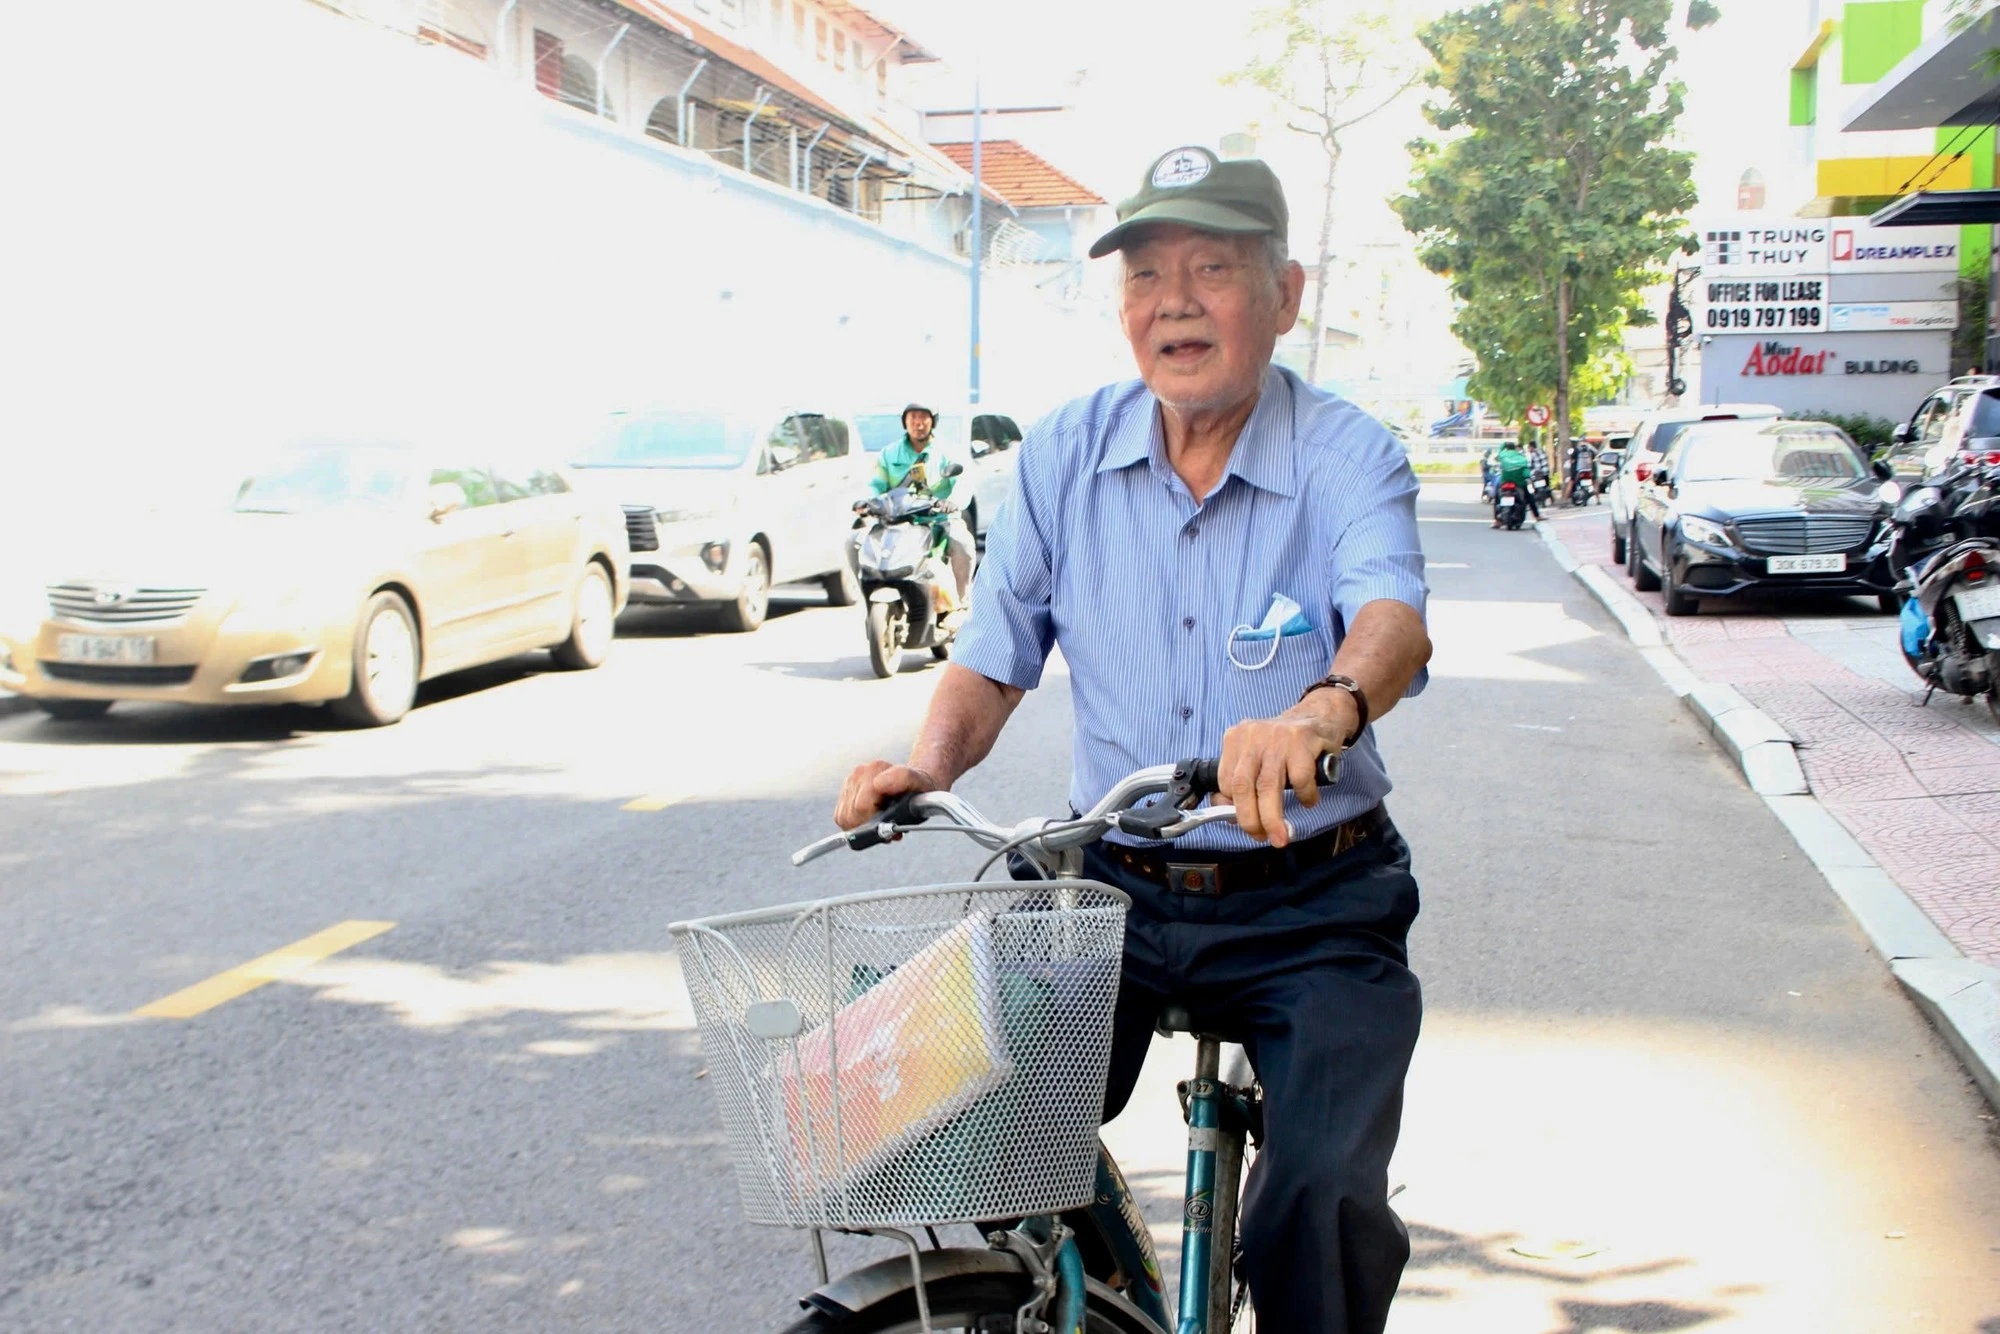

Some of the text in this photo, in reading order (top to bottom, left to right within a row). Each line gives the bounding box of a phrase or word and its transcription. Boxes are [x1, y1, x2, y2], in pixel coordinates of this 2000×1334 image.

[1748, 229, 1825, 243] TRUNG
[1748, 250, 1808, 264] THUY
[1855, 244, 1956, 260] DREAMPLEX
[1708, 281, 1822, 302] OFFICE FOR LEASE
[1707, 307, 1820, 327] 0919 797 199
[1763, 341, 1793, 356] Miss
[1845, 359, 1919, 375] BUILDING
